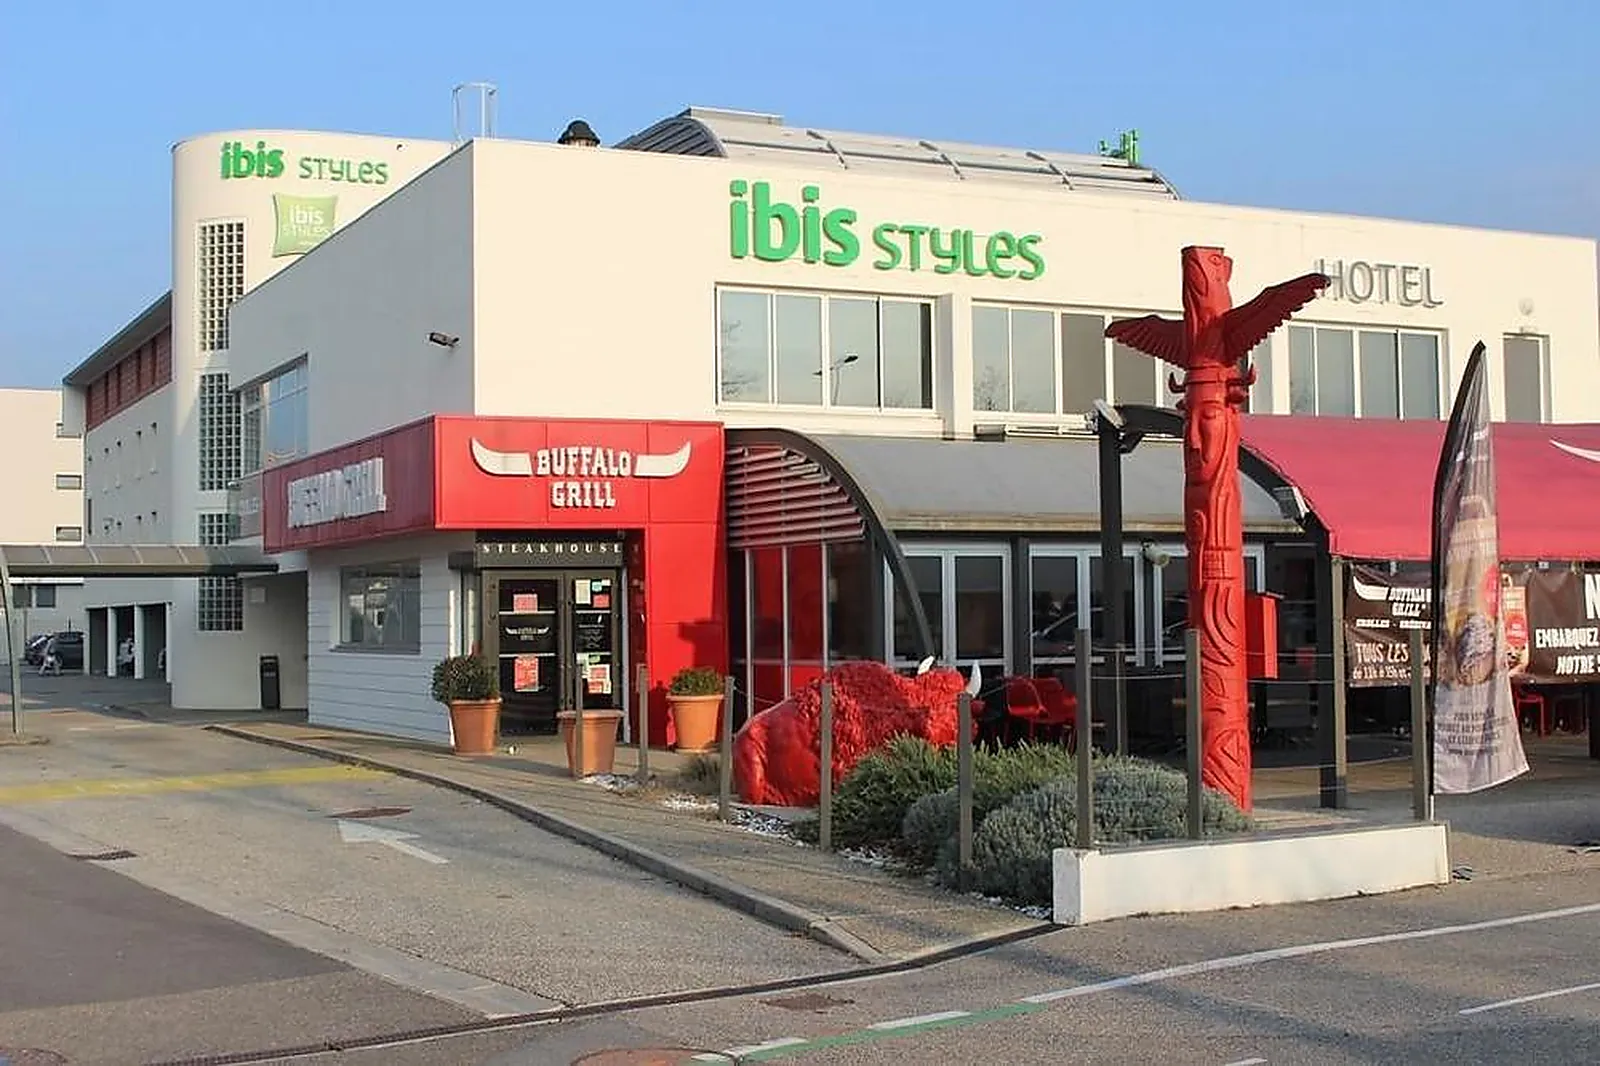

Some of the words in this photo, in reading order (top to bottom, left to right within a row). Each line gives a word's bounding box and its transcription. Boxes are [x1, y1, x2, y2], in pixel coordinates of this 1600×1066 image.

[221, 141, 285, 179] ibis
[289, 204, 324, 225] ibis
[730, 179, 861, 267] ibis
[1315, 258, 1444, 308] HOTEL
[536, 446, 632, 477] BUFFALO
[551, 480, 617, 508] GRILL
[482, 542, 622, 554] STEAKHOUSE
[1535, 627, 1600, 650] EMBARQUEZ
[1387, 642, 1409, 663] LES
[1555, 655, 1595, 674] NOTRE
